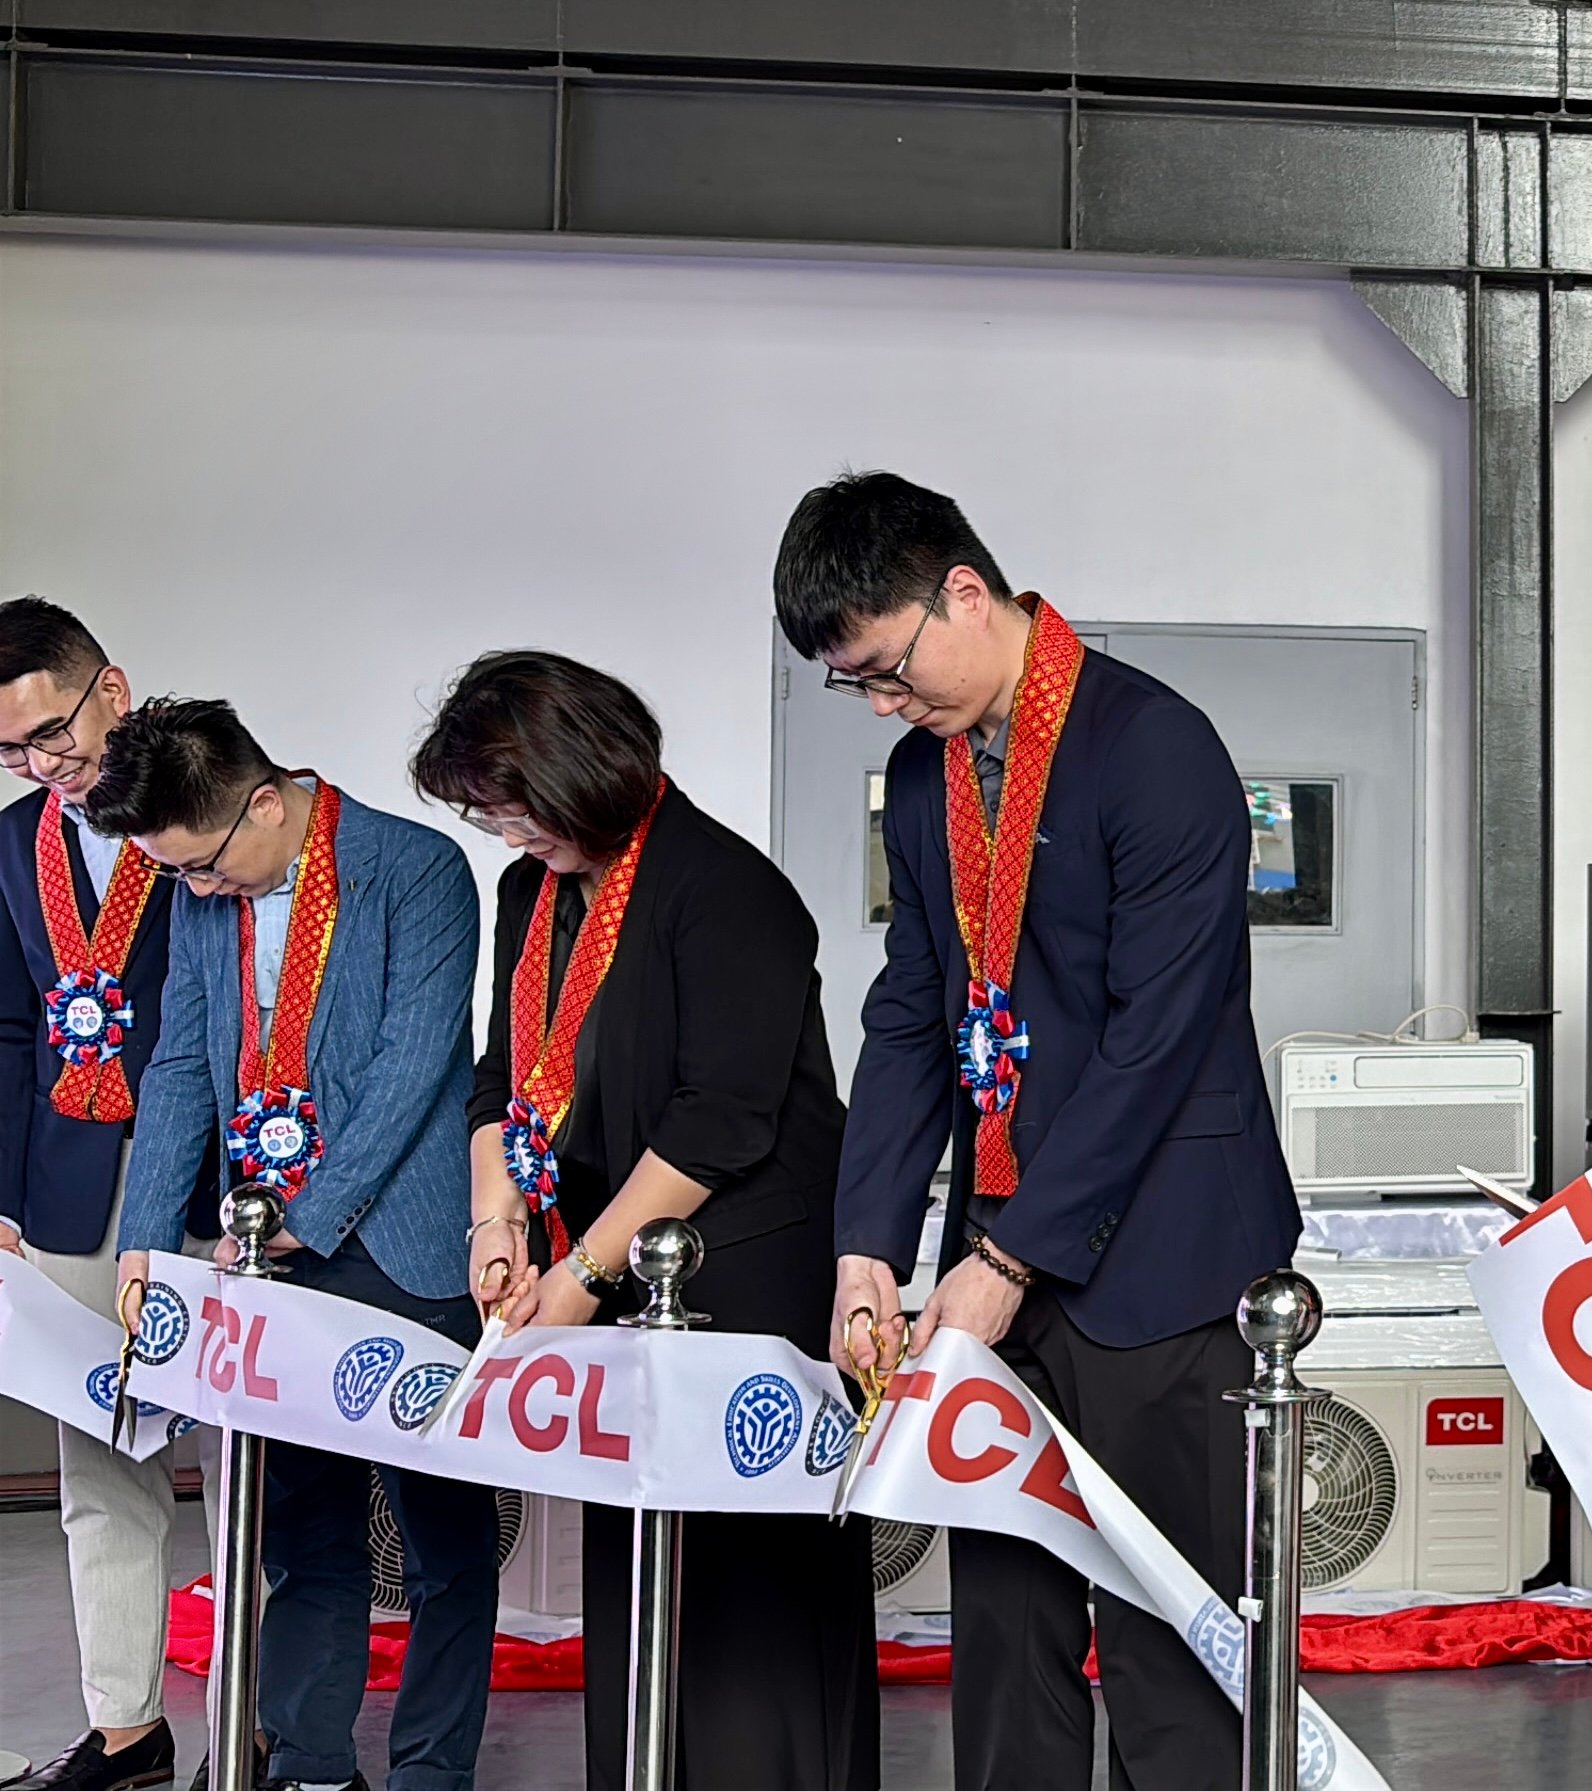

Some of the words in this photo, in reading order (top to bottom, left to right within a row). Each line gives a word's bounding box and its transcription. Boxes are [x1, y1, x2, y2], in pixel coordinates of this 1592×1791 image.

[71, 1005, 97, 1016] TCL
[263, 1124, 296, 1138] TCL
[196, 1296, 278, 1402] TCL
[459, 1353, 630, 1462] TCL
[1436, 1411, 1494, 1432] TCL
